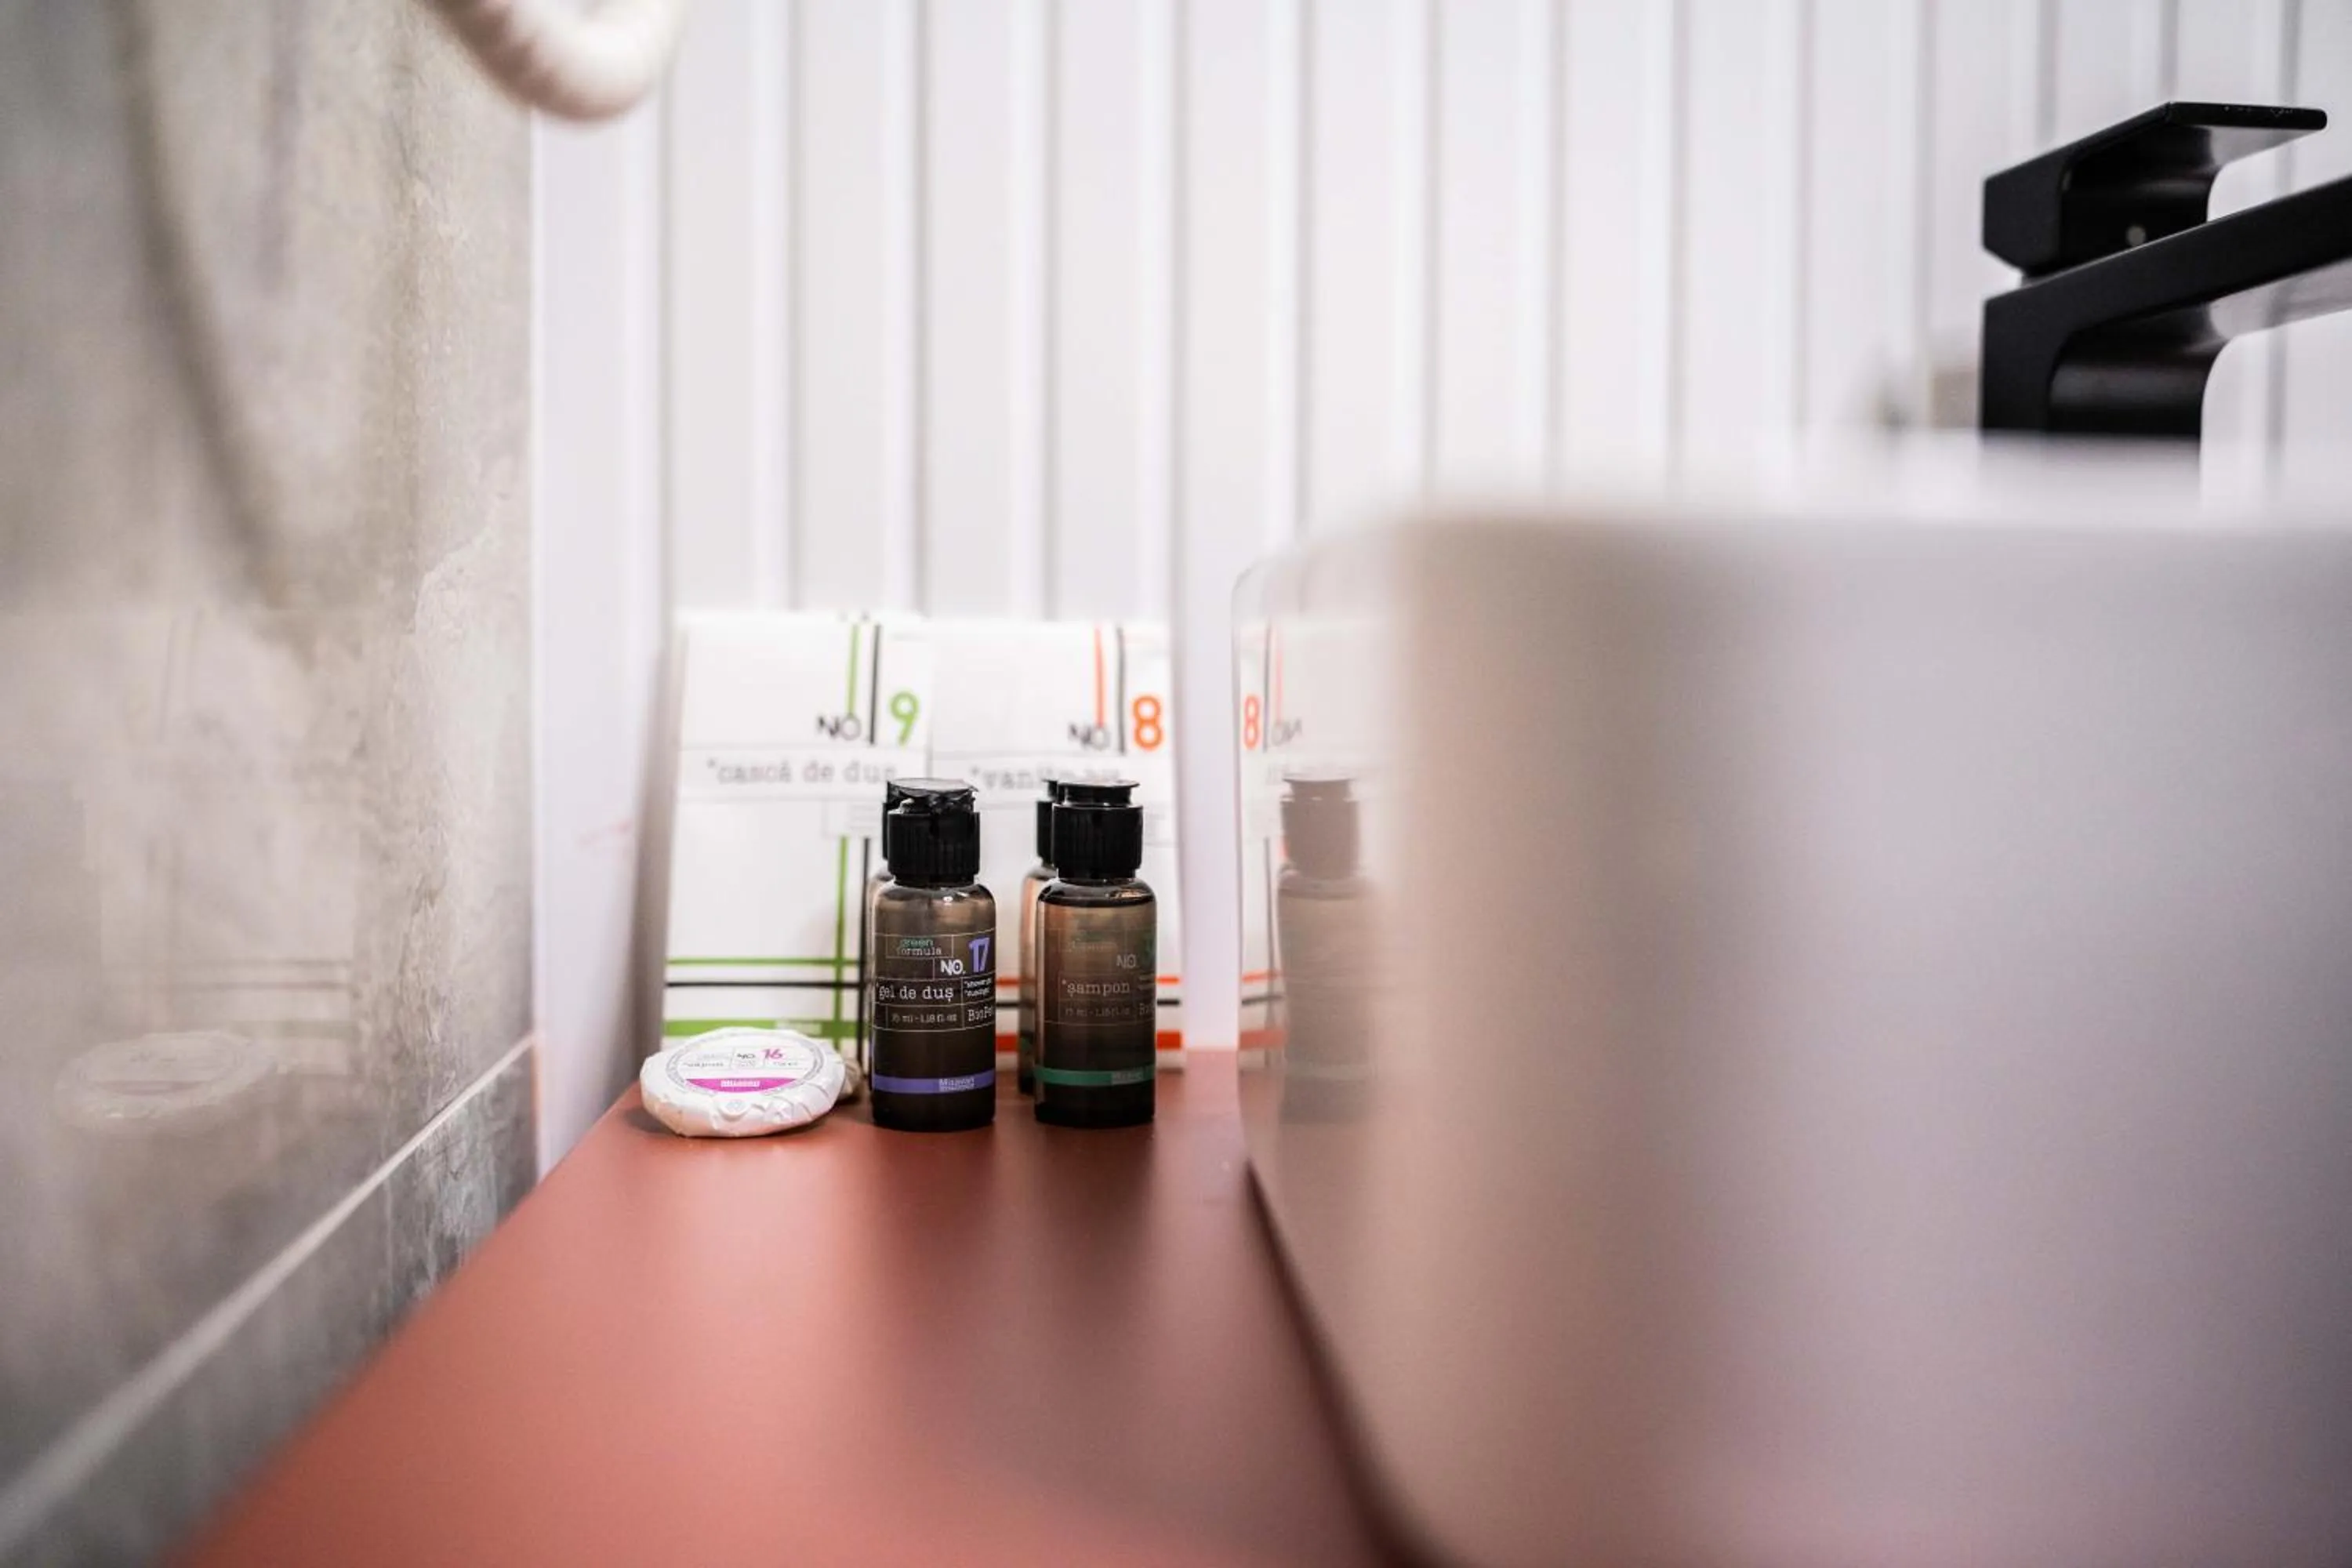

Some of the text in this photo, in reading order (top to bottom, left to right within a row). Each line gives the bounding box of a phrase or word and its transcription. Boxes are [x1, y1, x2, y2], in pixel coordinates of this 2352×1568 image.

[889, 690, 920, 746] 9
[1132, 695, 1163, 750] 8
[969, 936, 991, 973] 17
[899, 985, 917, 1000] de
[761, 1047, 785, 1059] 16
